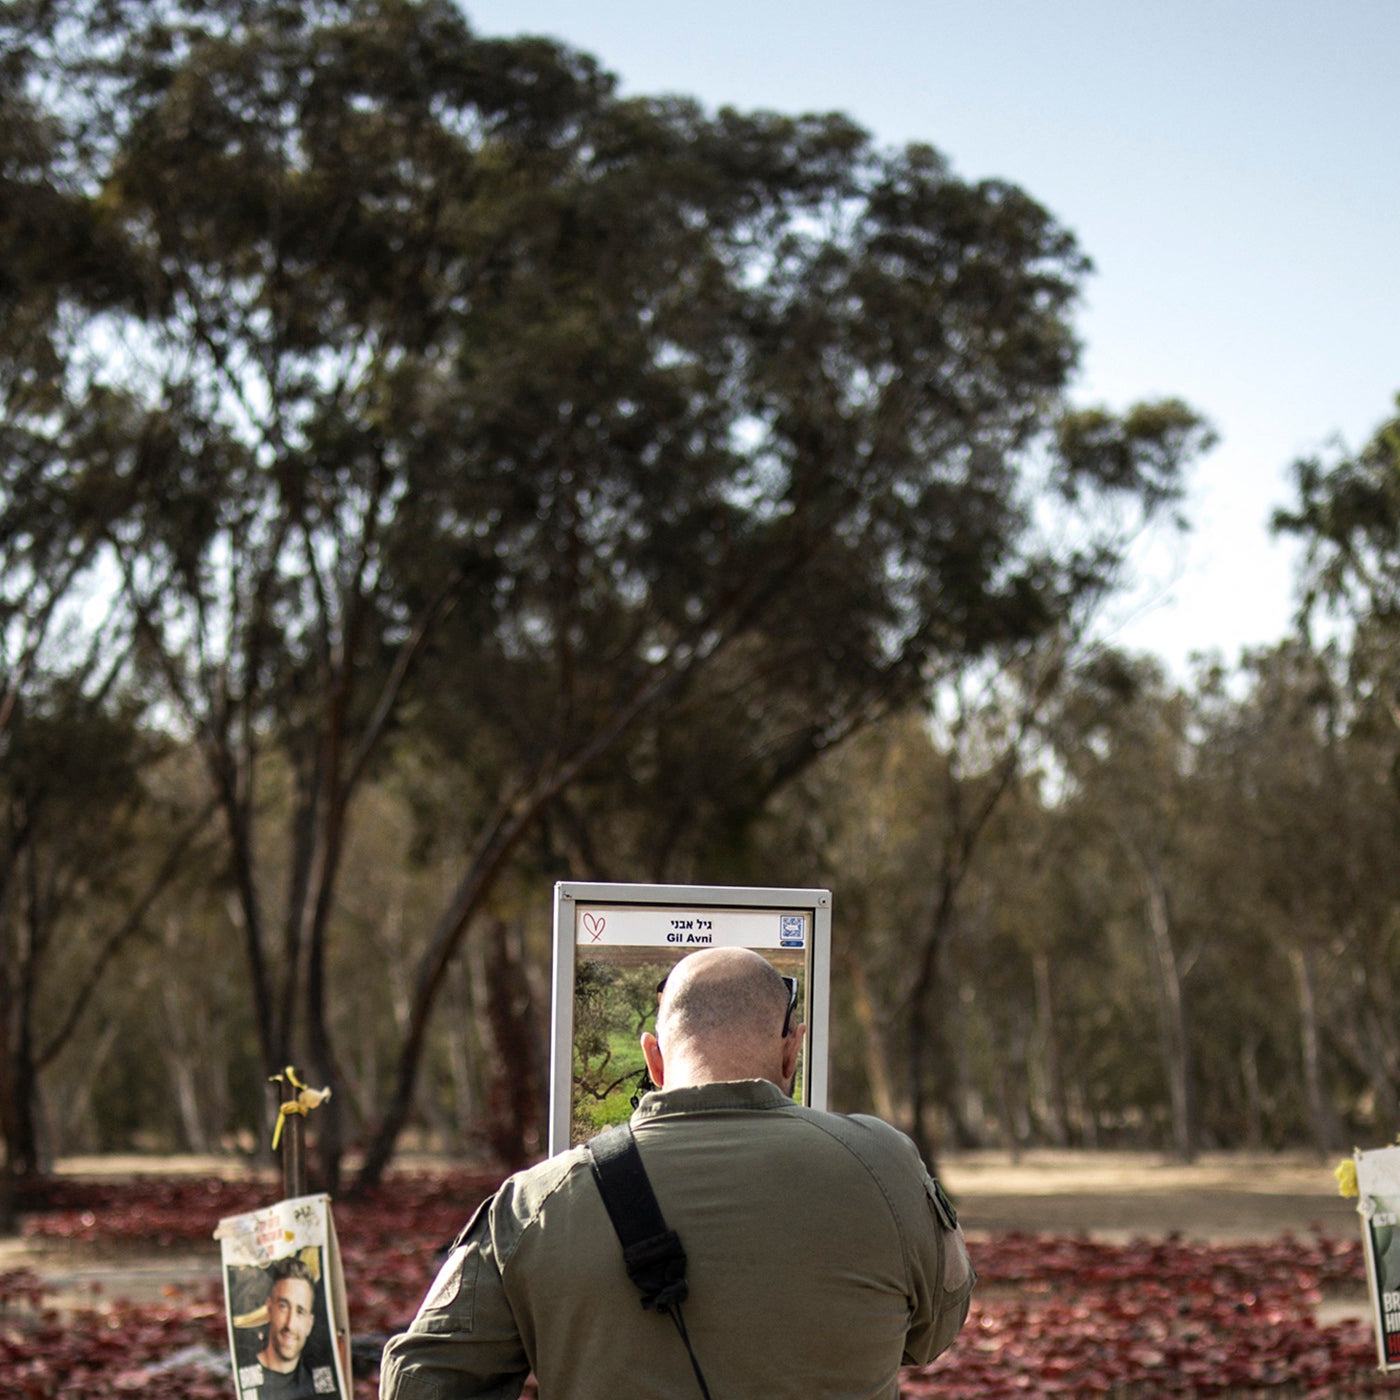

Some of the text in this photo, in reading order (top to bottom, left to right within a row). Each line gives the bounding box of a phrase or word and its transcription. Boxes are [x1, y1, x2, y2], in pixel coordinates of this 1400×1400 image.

[670, 919, 712, 930] גיל אבני
[667, 933, 712, 943] Gil Avni
